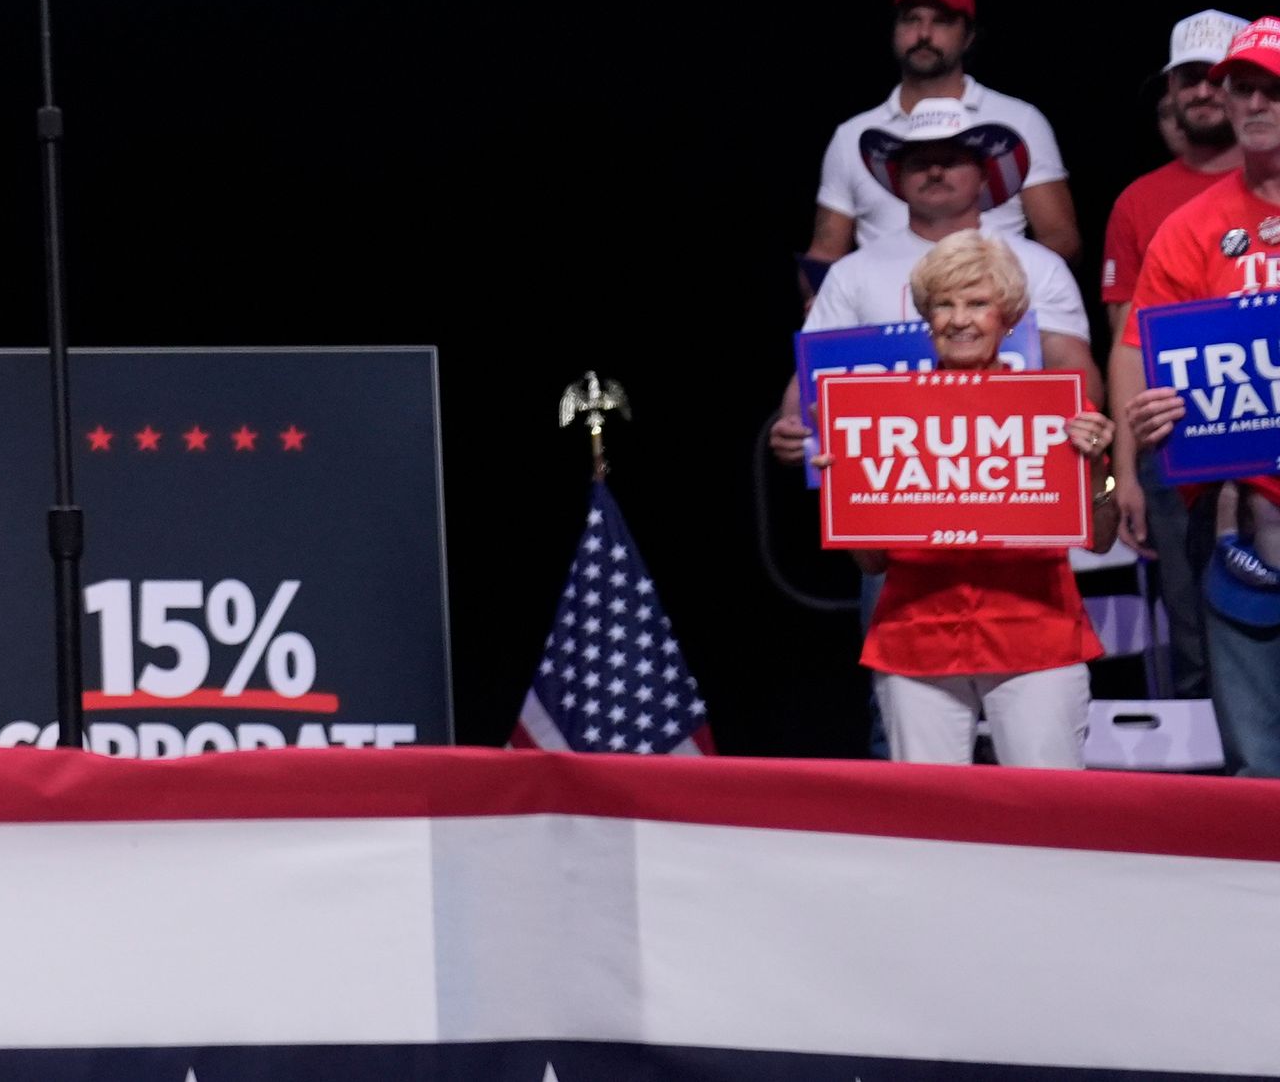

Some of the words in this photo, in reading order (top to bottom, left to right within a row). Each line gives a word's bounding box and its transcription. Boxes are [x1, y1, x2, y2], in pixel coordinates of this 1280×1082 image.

[834, 415, 1069, 458] TRUMP
[1184, 421, 1227, 438] MAKE
[860, 455, 1047, 491] VANCE
[850, 492, 890, 505] MAKE
[892, 492, 956, 505] AMERICA
[958, 492, 1006, 505] GREAT
[1008, 492, 1061, 505] AGAIN!
[931, 530, 979, 545] 2024
[83, 578, 317, 698] 15%
